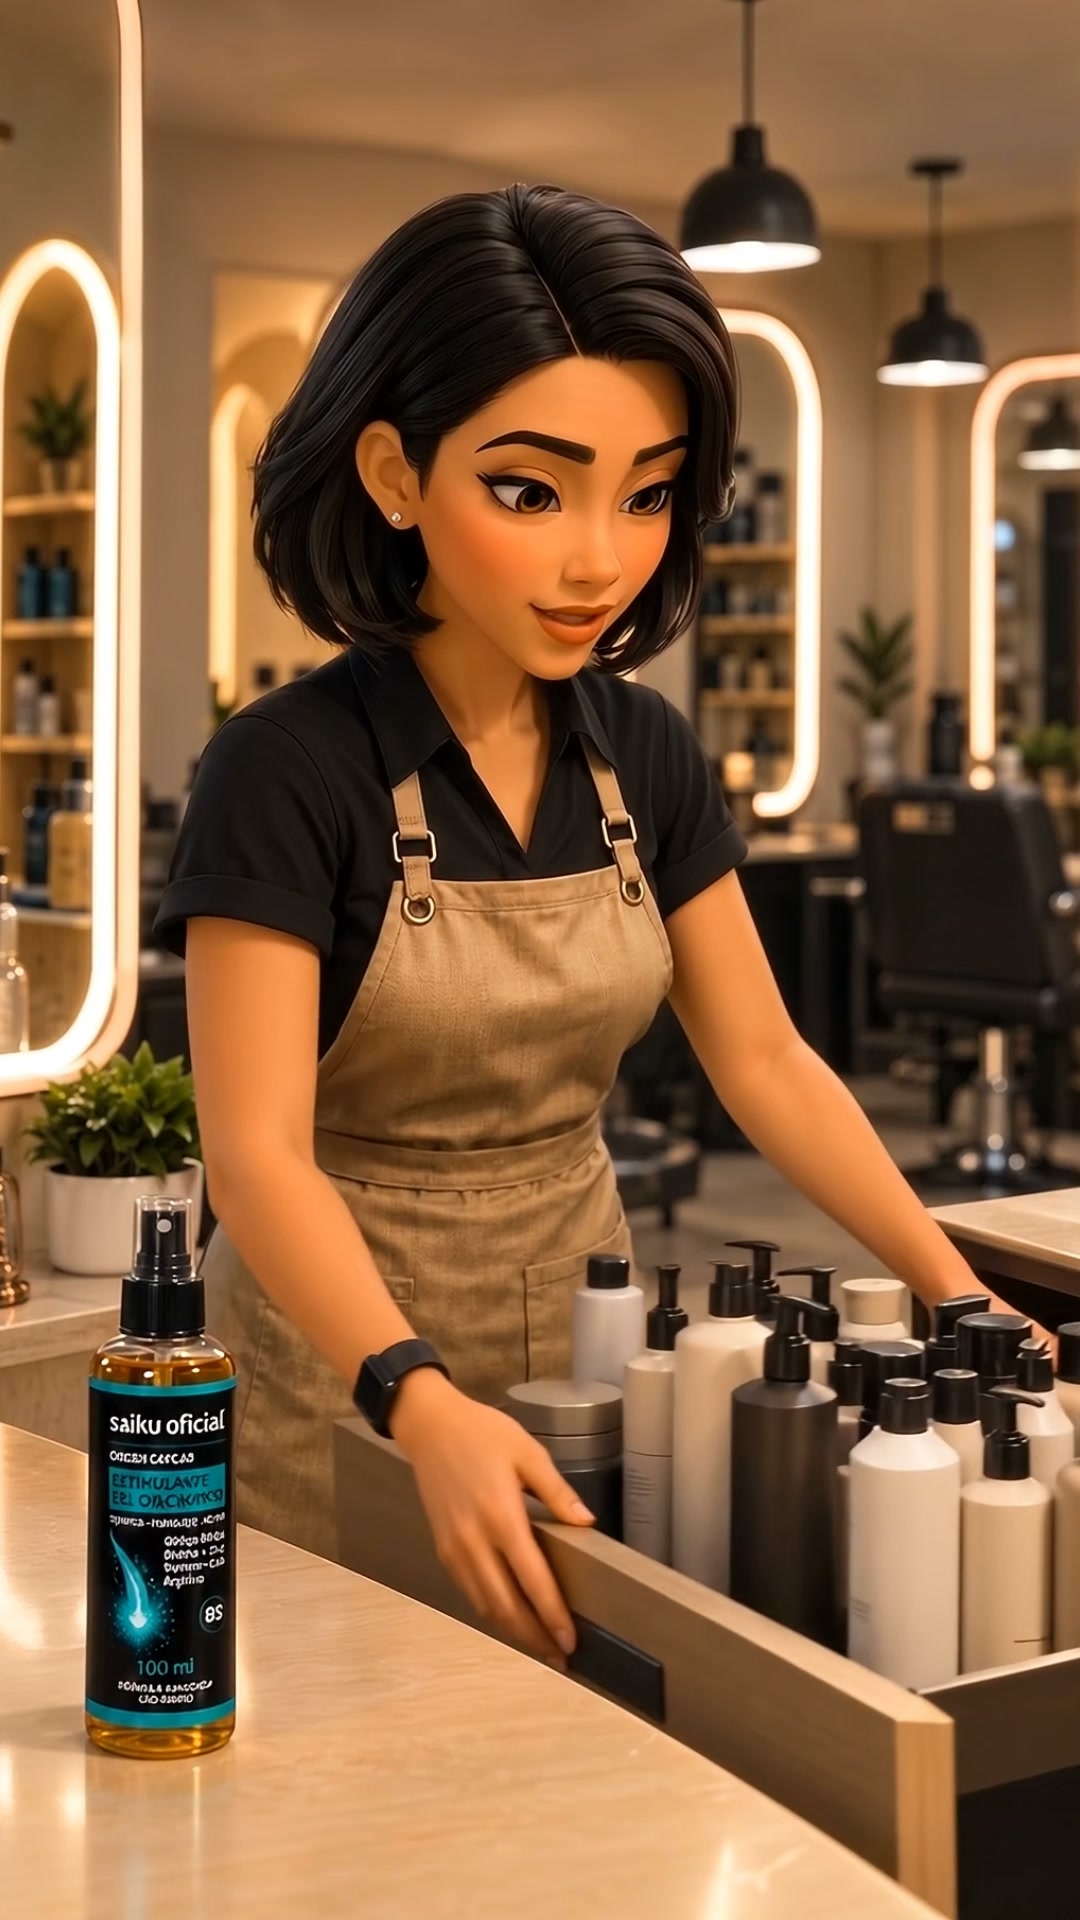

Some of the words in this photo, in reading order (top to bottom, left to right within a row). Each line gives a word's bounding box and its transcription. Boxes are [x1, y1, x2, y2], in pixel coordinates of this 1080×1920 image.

[109, 1413, 162, 1435] saiku
[166, 1408, 226, 1435] oficial
[137, 1659, 169, 1676] 100
